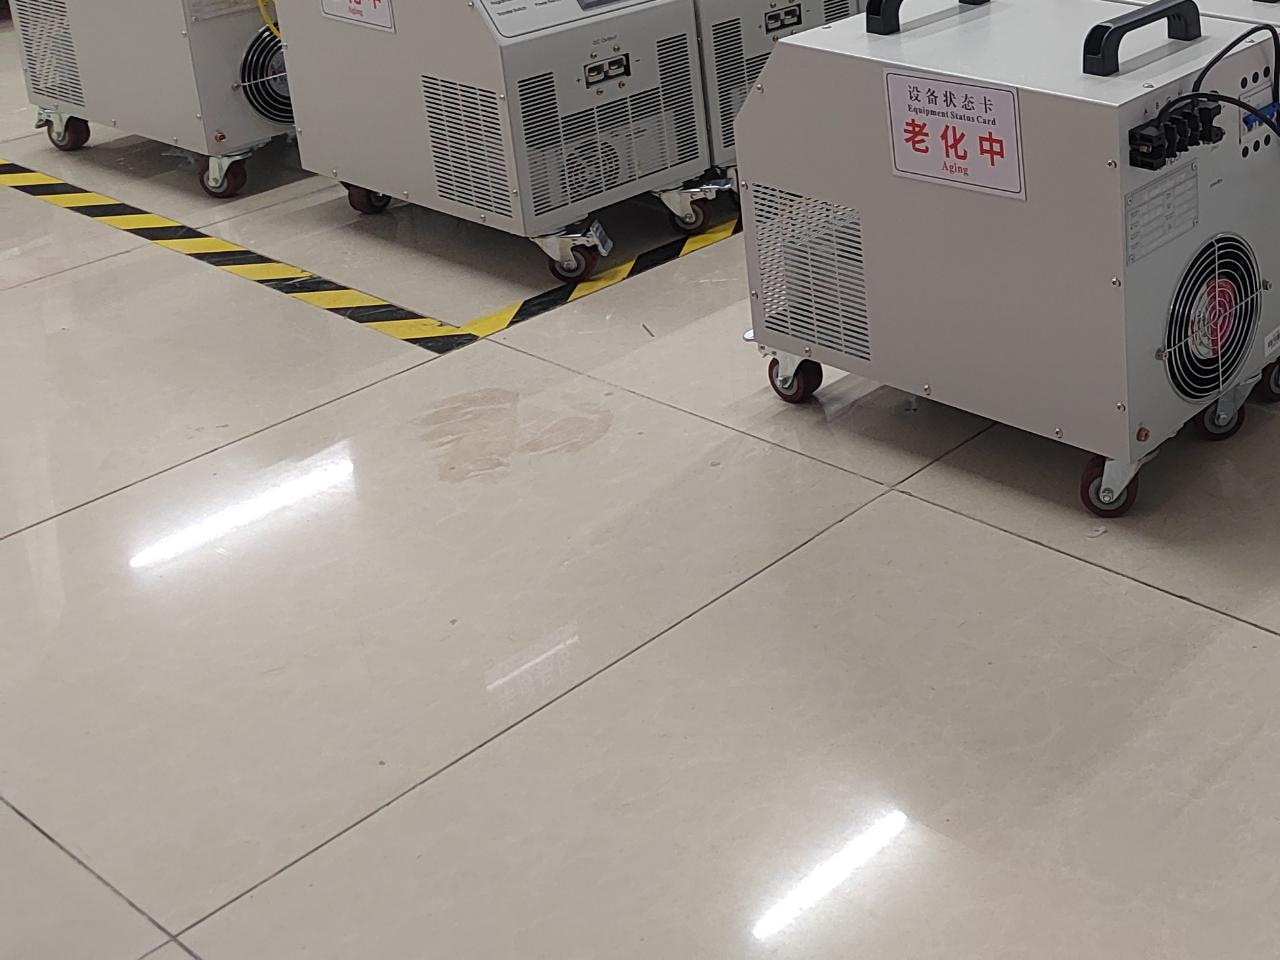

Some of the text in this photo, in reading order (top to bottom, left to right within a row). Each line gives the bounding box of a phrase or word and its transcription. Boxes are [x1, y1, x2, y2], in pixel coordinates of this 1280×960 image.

[908, 85, 994, 114] 设备状态卡
[907, 104, 996, 126] Equipment Status Card
[904, 119, 1005, 166] 老化中
[942, 161, 969, 176] Aging
